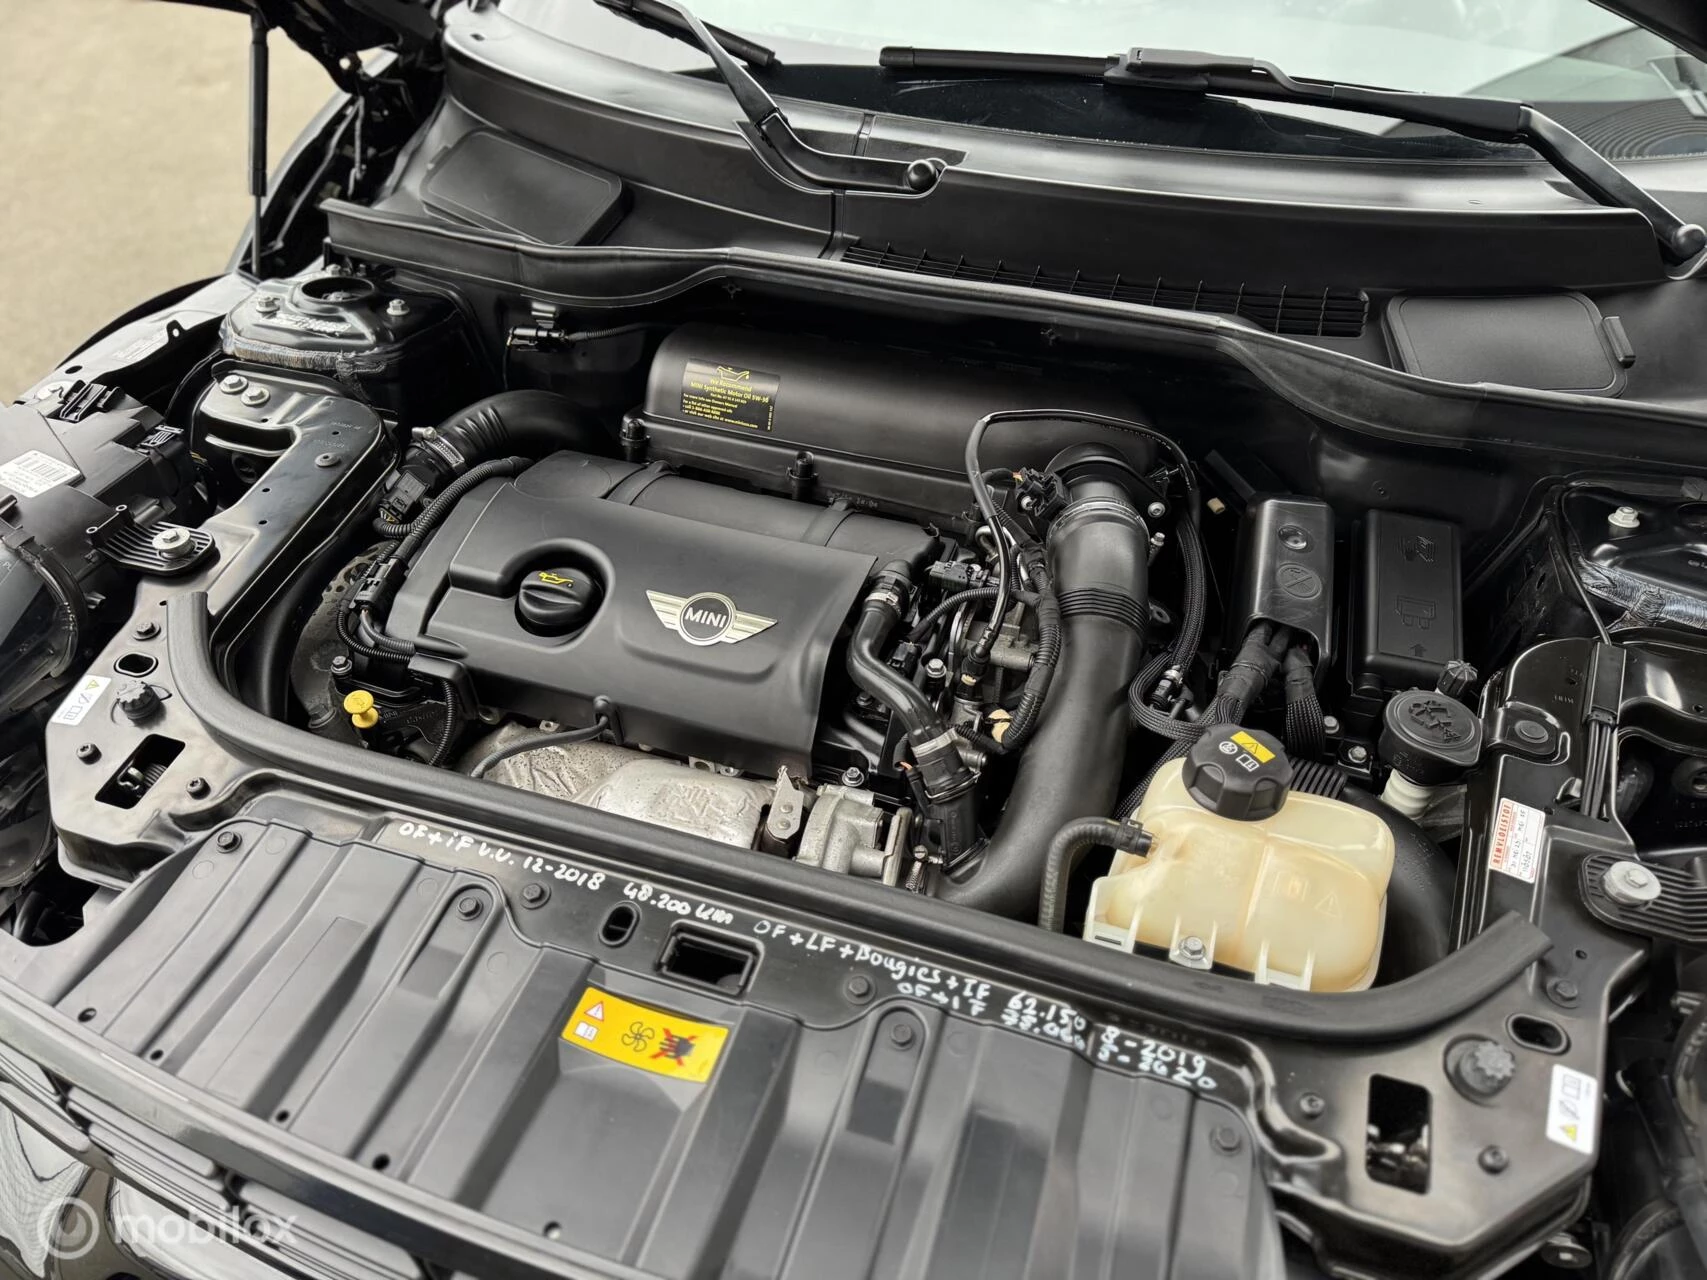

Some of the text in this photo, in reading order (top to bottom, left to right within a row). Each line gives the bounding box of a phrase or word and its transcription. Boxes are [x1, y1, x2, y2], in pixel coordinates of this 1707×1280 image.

[704, 385, 726, 394] Synthetic
[728, 390, 743, 398] Motor
[684, 607, 727, 628] MINI
[523, 856, 606, 891] 12-2018
[623, 882, 692, 916] 48.200
